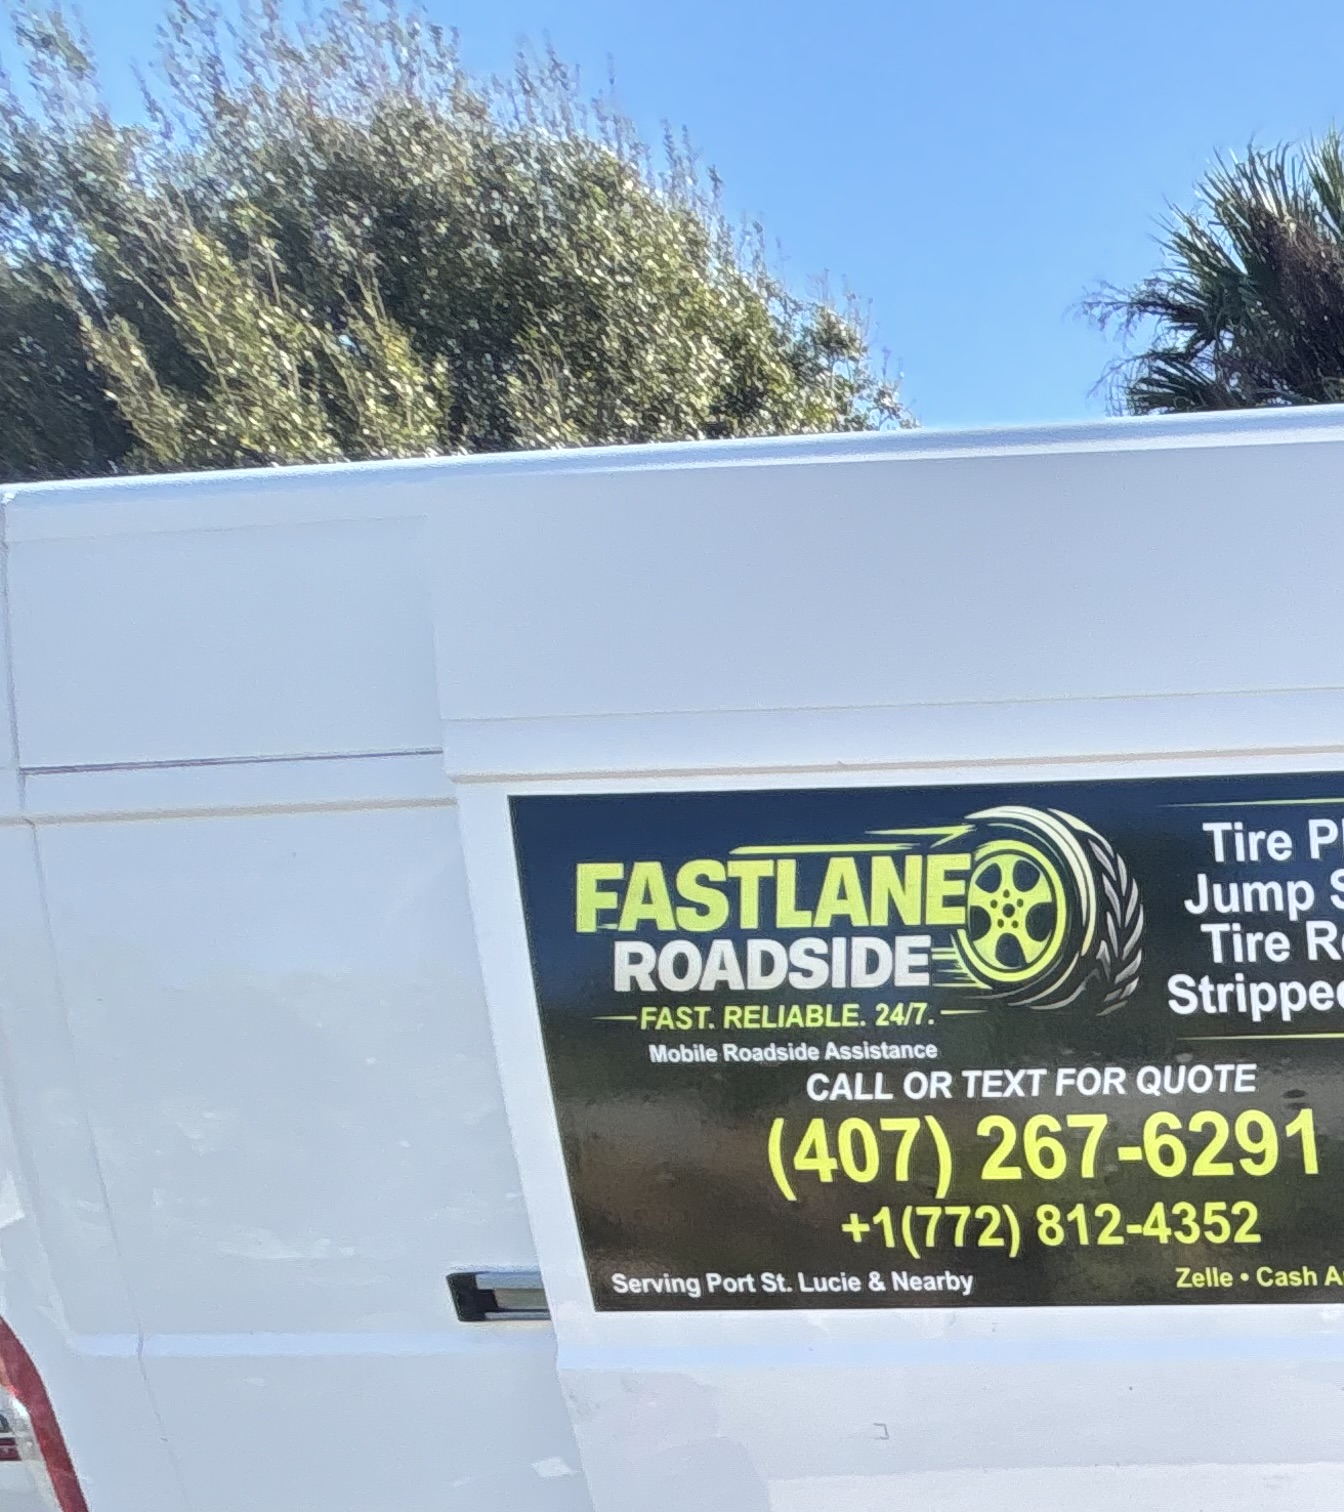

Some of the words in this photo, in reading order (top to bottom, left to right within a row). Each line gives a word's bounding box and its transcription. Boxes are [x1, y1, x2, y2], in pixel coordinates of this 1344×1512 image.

[1202, 821, 1292, 863] Tire
[575, 853, 971, 932] FASTLANE
[1184, 873, 1314, 921] Jump
[613, 935, 931, 991] ROADSIDE
[1200, 922, 1291, 963] Tire
[640, 1005, 715, 1029] FAST.
[723, 1003, 866, 1029] RELIABLE.
[875, 1002, 934, 1027] 24/7.
[649, 1044, 718, 1063] Mobile
[723, 1042, 820, 1062] Roadside
[824, 1040, 938, 1060] Assistance
[806, 1073, 893, 1101] CALL
[903, 1071, 952, 1099] OR
[962, 1068, 1047, 1097] TEXT
[1055, 1066, 1126, 1095] FOR
[1136, 1063, 1257, 1095] QUOTE
[768, 1115, 953, 1201] (407)
[976, 1108, 1319, 1180] 267-6291
[842, 1204, 1020, 1258] +1(772)
[1037, 1200, 1261, 1246] 812-4352
[612, 1272, 701, 1297] Serving
[706, 1272, 754, 1294] Port
[761, 1271, 793, 1294] St.
[798, 1271, 862, 1293] Lucie
[868, 1272, 886, 1293] &
[892, 1271, 974, 1297] Nearby
[1176, 1266, 1233, 1288] Zelle
[1256, 1264, 1318, 1287] Cash
